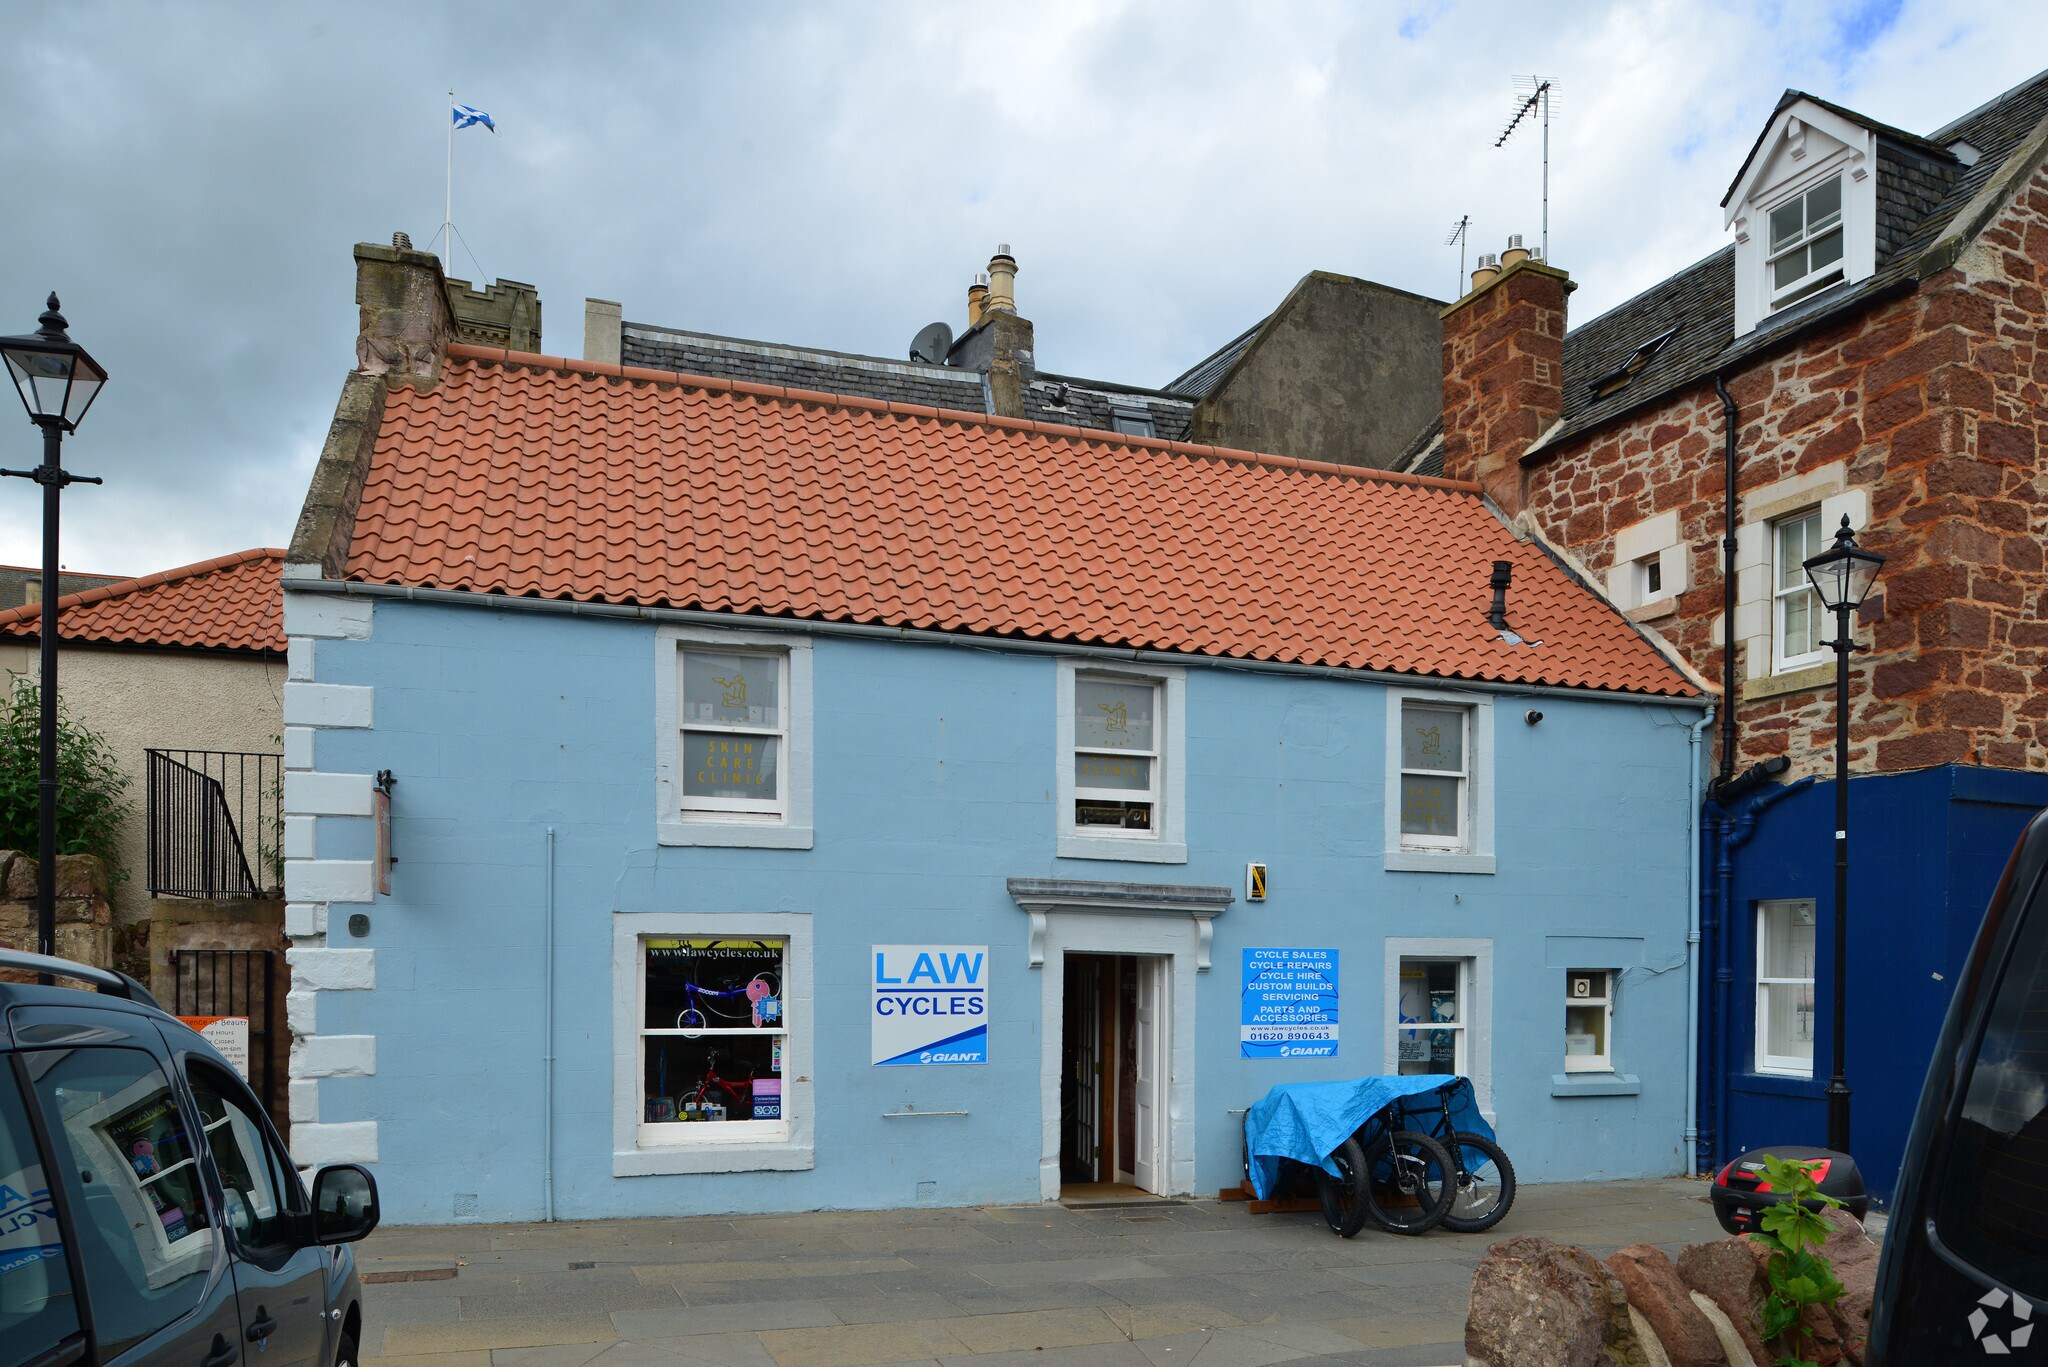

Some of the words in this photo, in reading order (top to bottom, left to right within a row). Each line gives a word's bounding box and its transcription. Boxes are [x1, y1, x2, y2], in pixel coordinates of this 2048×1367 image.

[709, 741, 752, 754] SKIN
[707, 756, 753, 770] CARE
[697, 771, 763, 785] CLINIC
[650, 947, 779, 960] www.lawcycles.co.uk
[1255, 951, 1289, 959] CYCLE
[1292, 951, 1327, 959] SALES
[876, 952, 984, 984] LAW
[1249, 961, 1284, 969] CYCLE
[1287, 961, 1332, 970] REPAIRS
[1260, 972, 1294, 980] CYCLE
[1297, 972, 1322, 980] HIRE
[1247, 982, 1292, 990] CUSTOM
[1295, 982, 1333, 990] BUILDS
[1262, 993, 1319, 1001] SERVICING
[876, 997, 984, 1016] CYCLES
[1252, 1014, 1328, 1022] ACCESSORIES
[221, 1019, 248, 1027] Beauty
[1250, 1032, 1283, 1041] 01620
[1287, 1032, 1330, 1040] 890643
[1290, 1047, 1332, 1056] GIANT
[932, 1052, 981, 1062] GIANT
